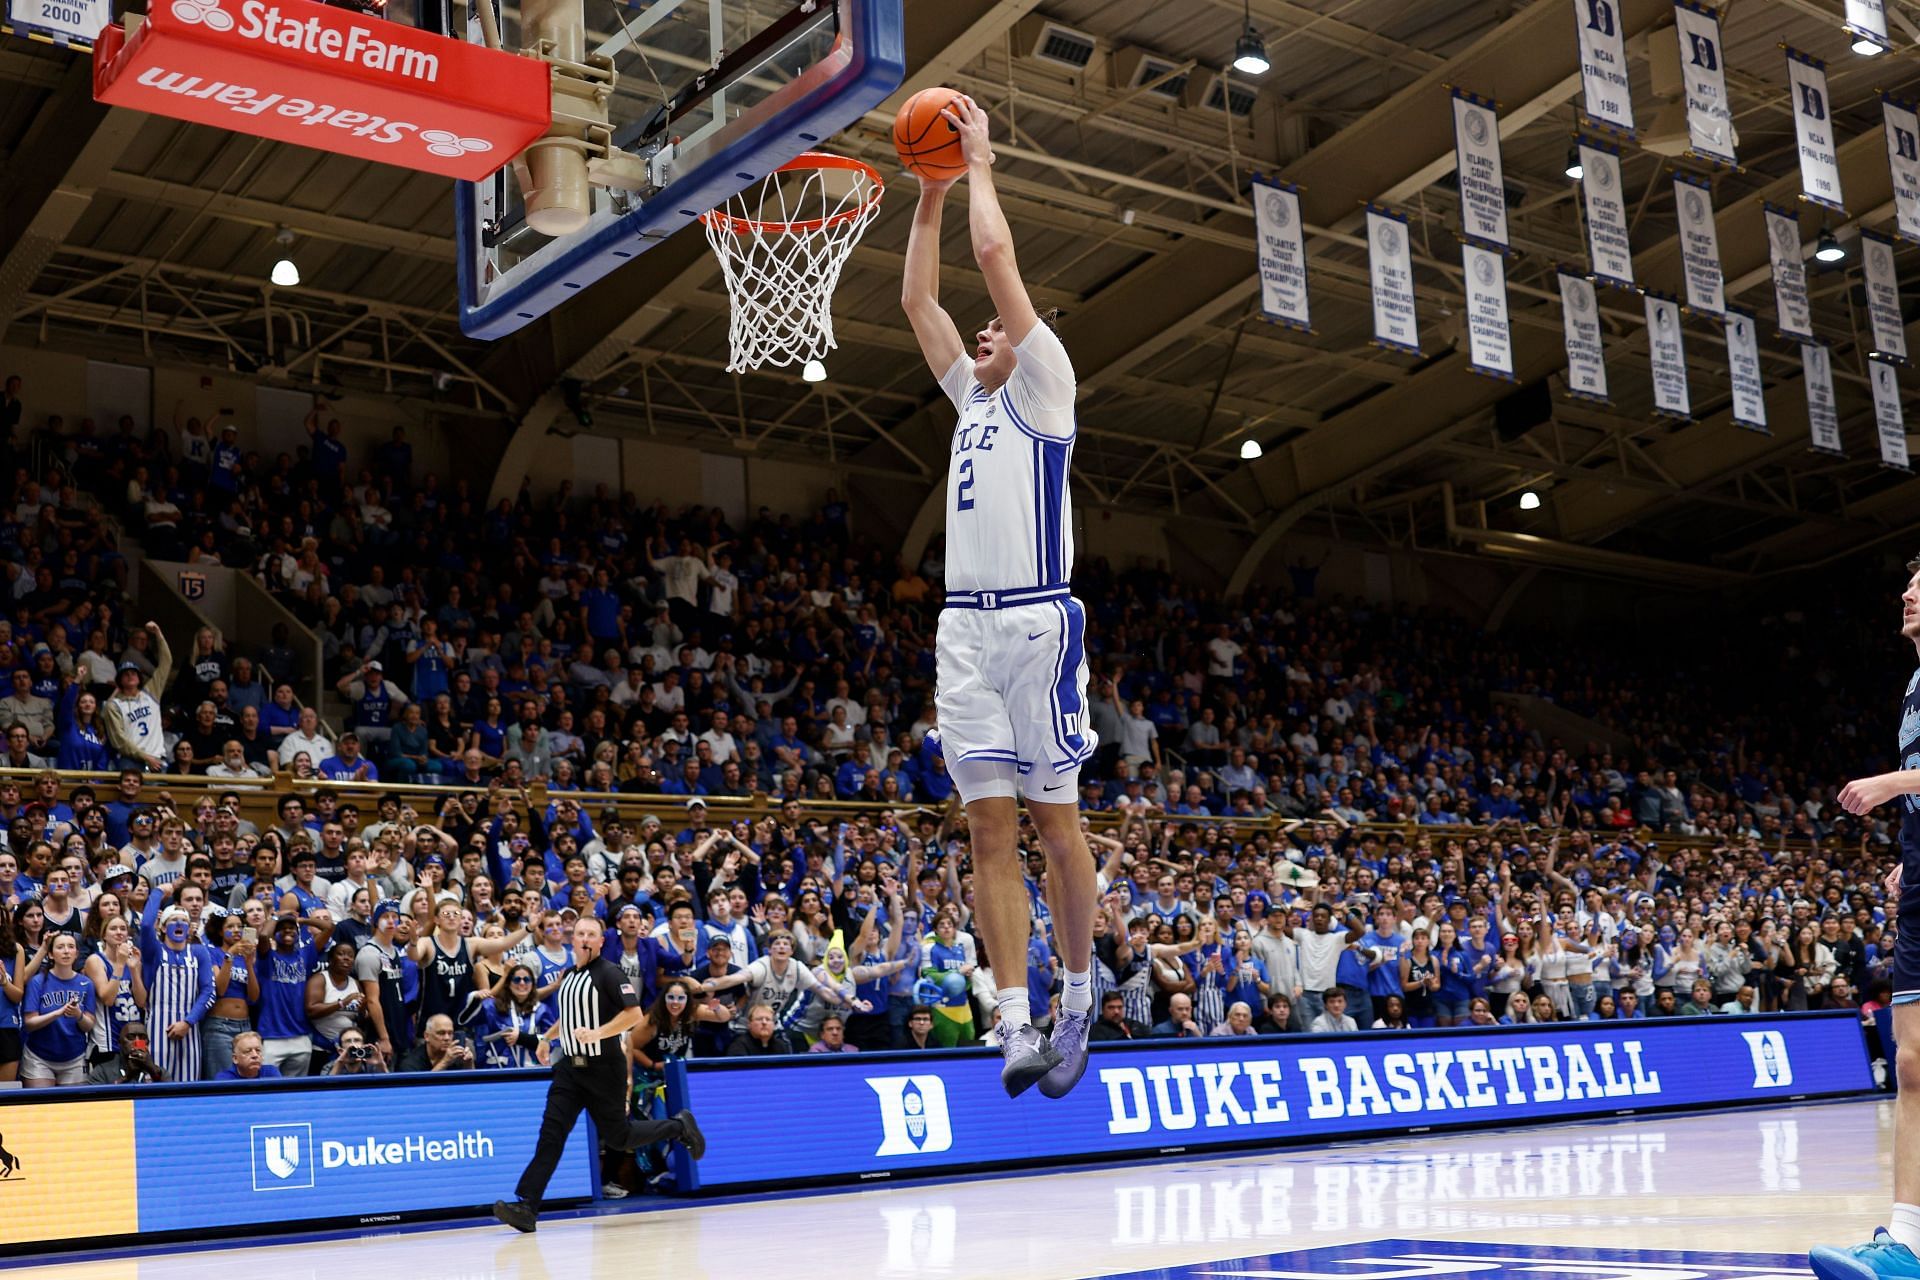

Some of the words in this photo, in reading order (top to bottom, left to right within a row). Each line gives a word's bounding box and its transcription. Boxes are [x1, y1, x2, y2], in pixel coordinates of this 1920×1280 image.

[42, 3, 81, 25] 2000
[1593, 48, 1615, 64] NCAA
[1467, 153, 1494, 171] ATLANTIC
[1471, 167, 1492, 180] COAST
[1463, 176, 1503, 198] CONFERENCE
[1466, 189, 1503, 210] CHAMPIONS
[1265, 235, 1297, 250] ATLANTIC
[1272, 248, 1293, 261] COAST
[1262, 257, 1304, 277] CONFERENCE
[1378, 265, 1407, 280] ATLANTIC
[1264, 271, 1303, 288] CHAMPIONS
[1384, 277, 1402, 289] COAST
[1374, 286, 1413, 304] CONFERENCE
[1474, 293, 1501, 307] ATLANTIC
[1377, 298, 1413, 315] CHAMPIONS
[1479, 305, 1498, 317] COAST
[1470, 314, 1508, 331] CONFERENCE
[1473, 325, 1508, 341] CHAMPIONS
[957, 458, 976, 512] 2
[184, 578, 203, 598] 15
[127, 705, 153, 723] DUKE
[137, 721, 149, 737] 3
[437, 961, 467, 976] Duke
[448, 977, 456, 998] 1
[1099, 1059, 1290, 1135] DUKE
[1299, 1040, 1662, 1120] BASKETBALL
